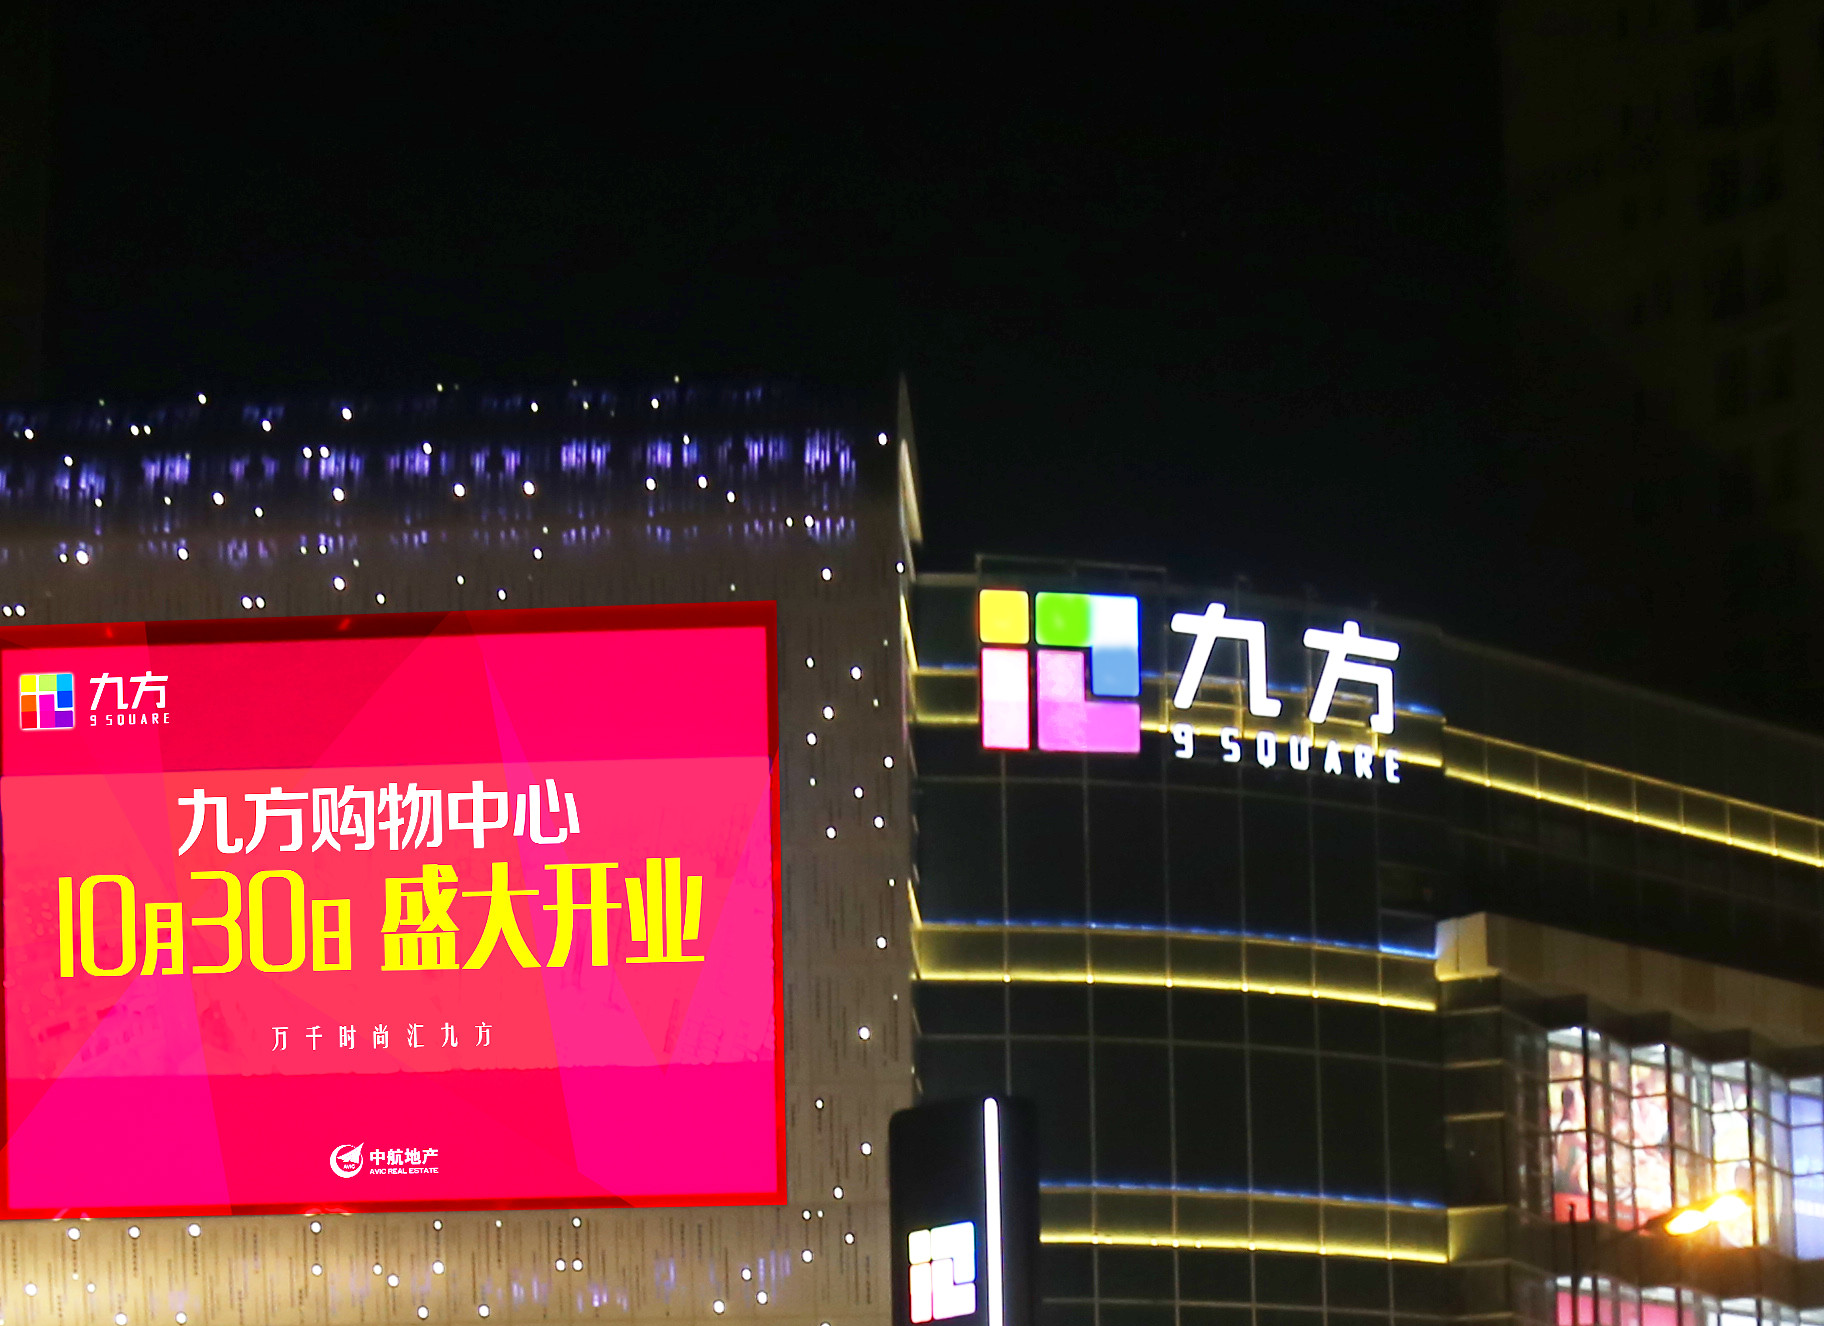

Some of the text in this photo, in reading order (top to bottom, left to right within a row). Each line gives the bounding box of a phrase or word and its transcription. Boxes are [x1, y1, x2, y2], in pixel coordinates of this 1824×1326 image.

[1170, 601, 1400, 735] 九方
[89, 670, 169, 711] 九方
[89, 712, 170, 727] 9 SQUARE
[1172, 722, 1401, 784] 9 SQUARE
[178, 778, 582, 857] 九方购物中心
[57, 856, 706, 978] 10月30日 盛大开业
[271, 1020, 495, 1052] 万千时尚汇九方
[369, 1147, 439, 1166] 中航地产
[387, 1167, 408, 1175] REAL
